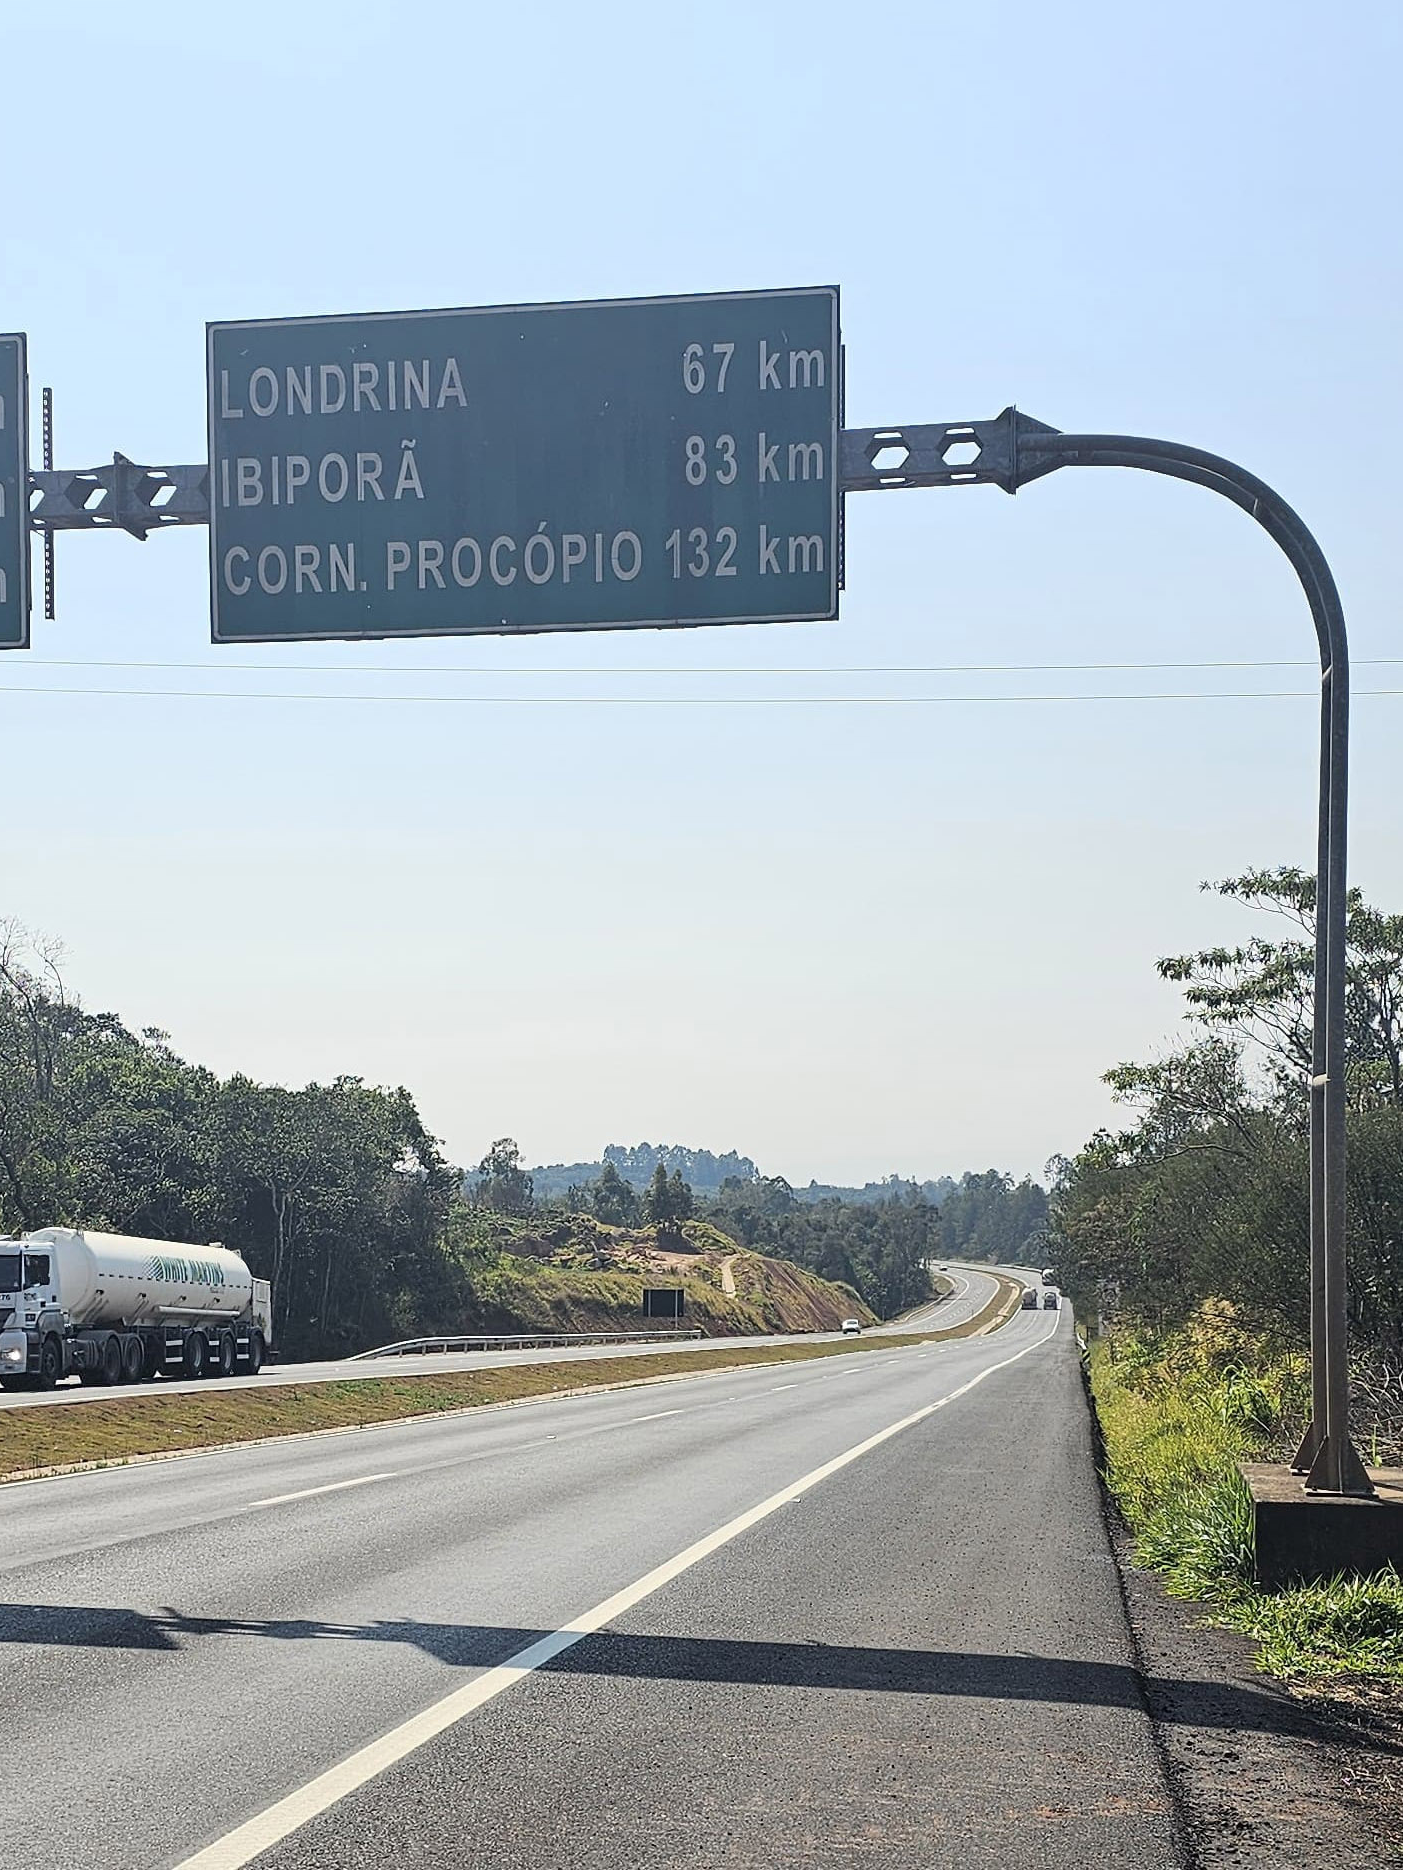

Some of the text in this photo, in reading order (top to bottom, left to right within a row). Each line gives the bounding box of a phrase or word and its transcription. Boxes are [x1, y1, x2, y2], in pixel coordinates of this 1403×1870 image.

[220, 340, 826, 420] LONDRINA 67 km
[220, 432, 825, 509] IBIPORÃ 83 km
[223, 521, 825, 597] CORN. PROCÓPIO 132 km
